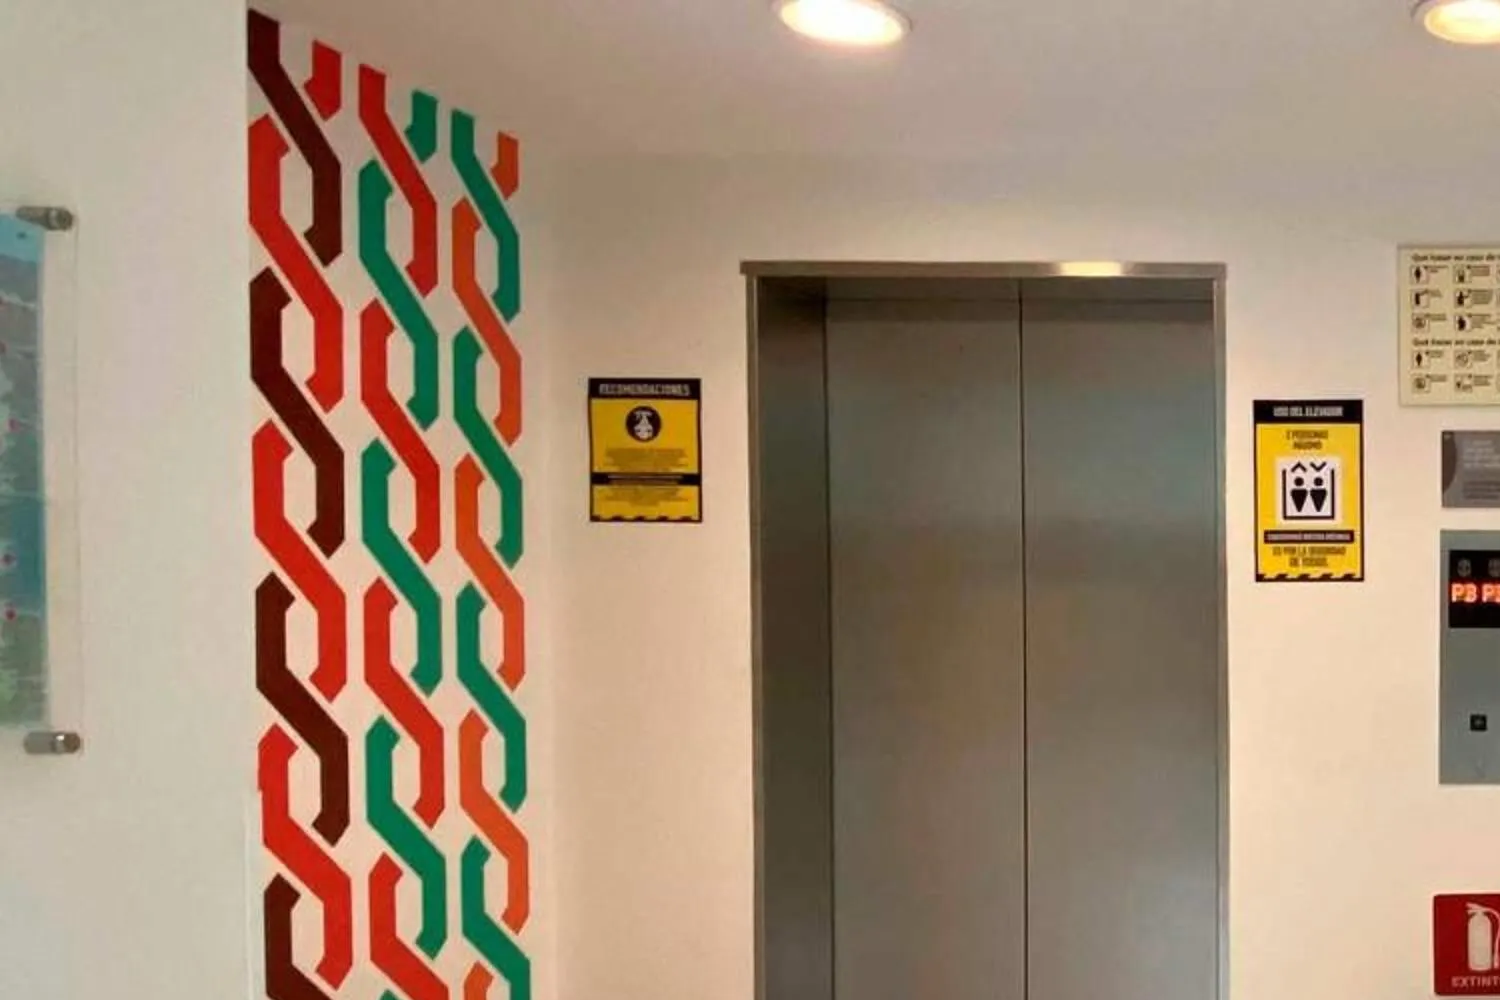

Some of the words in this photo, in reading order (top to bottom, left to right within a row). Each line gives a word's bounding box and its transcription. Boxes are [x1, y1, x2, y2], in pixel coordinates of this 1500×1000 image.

[599, 383, 690, 396] RECOMENDACIONES
[1273, 406, 1289, 417] USO
[1290, 406, 1304, 417] DEL
[1305, 406, 1343, 417] ELEVADOR
[1451, 583, 1478, 603] PB
